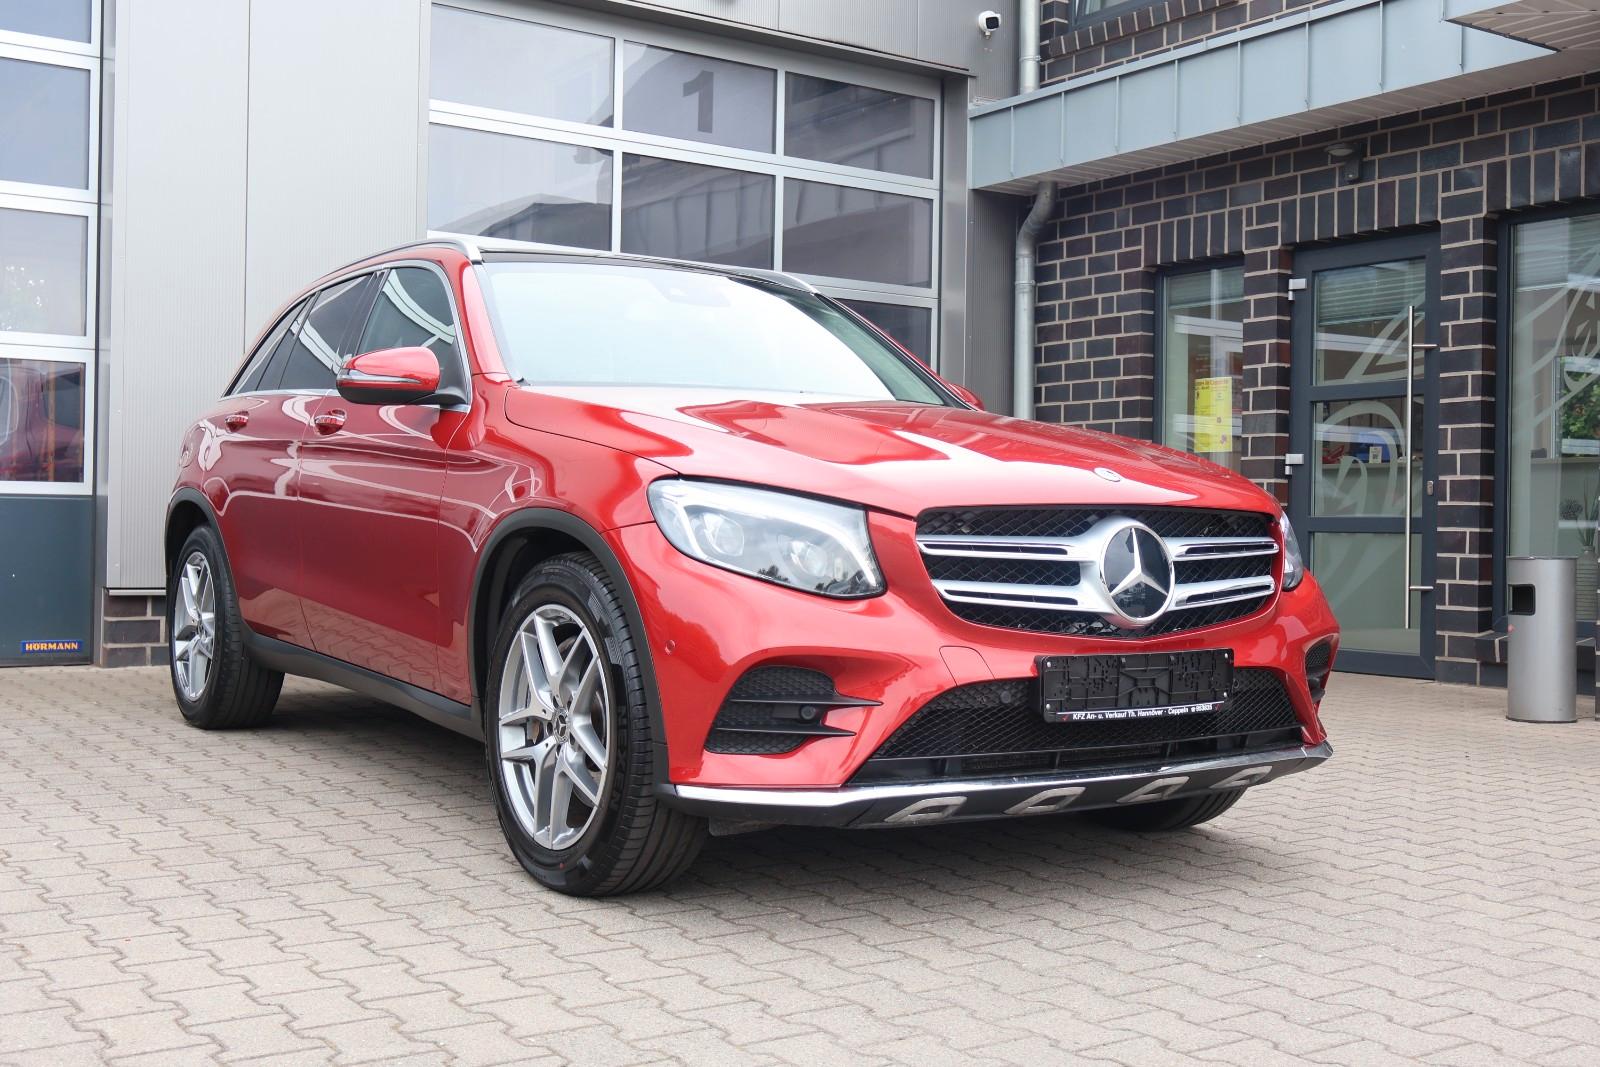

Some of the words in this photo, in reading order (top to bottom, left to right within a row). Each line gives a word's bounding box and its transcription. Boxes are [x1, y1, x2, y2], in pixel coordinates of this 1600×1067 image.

[682, 70, 714, 134] 1
[1072, 712, 1086, 720] KFZ
[1105, 711, 1127, 719] Verkauf
